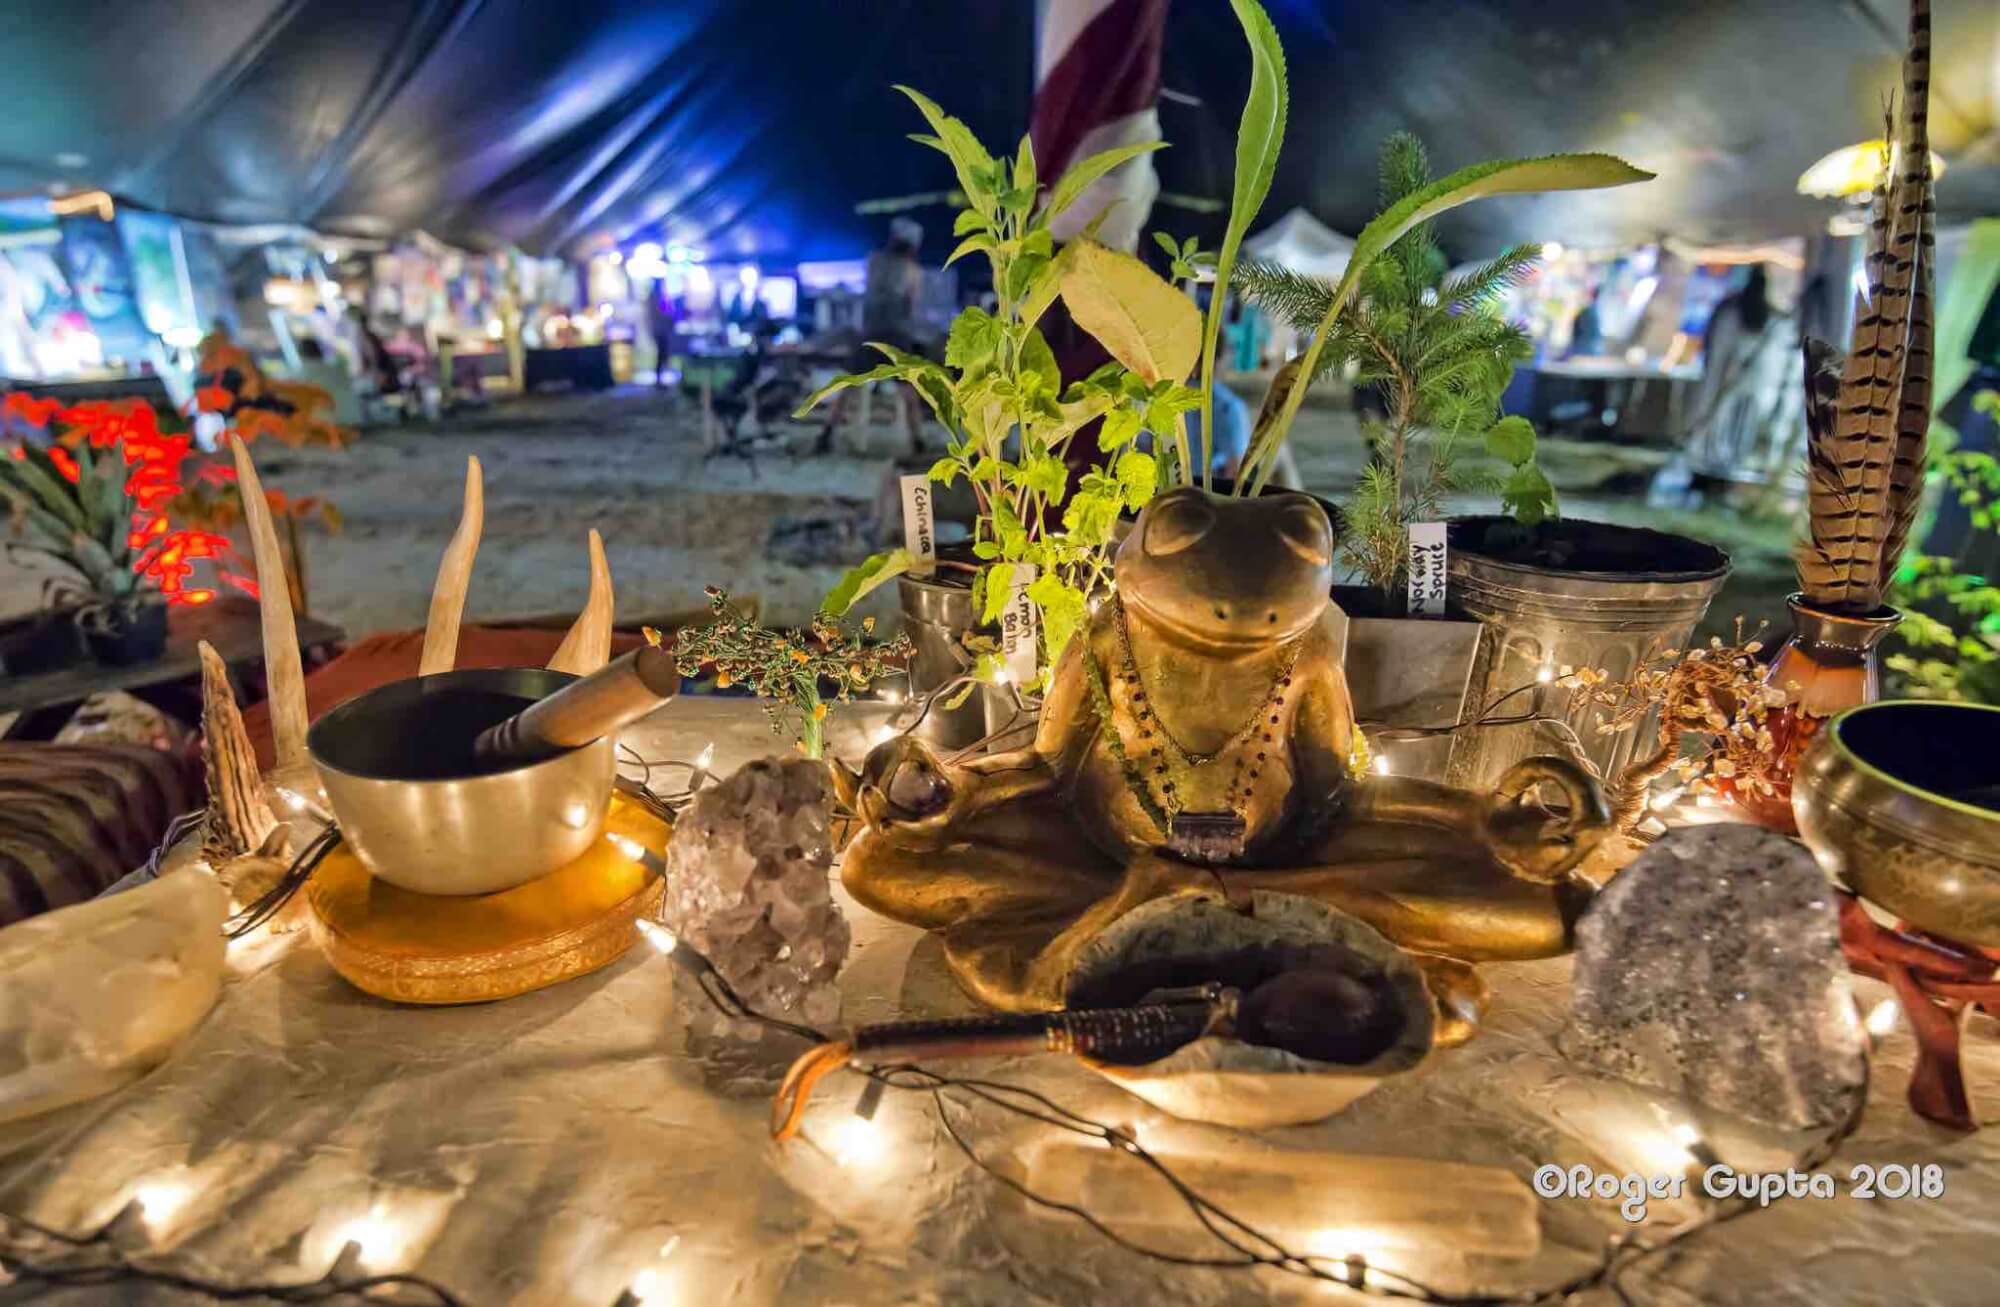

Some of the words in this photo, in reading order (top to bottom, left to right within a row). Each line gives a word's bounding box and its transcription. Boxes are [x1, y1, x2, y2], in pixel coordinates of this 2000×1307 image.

[914, 487, 931, 554] Echinacea
[1412, 544, 1431, 614] Norway
[1429, 542, 1445, 600] Spruce
